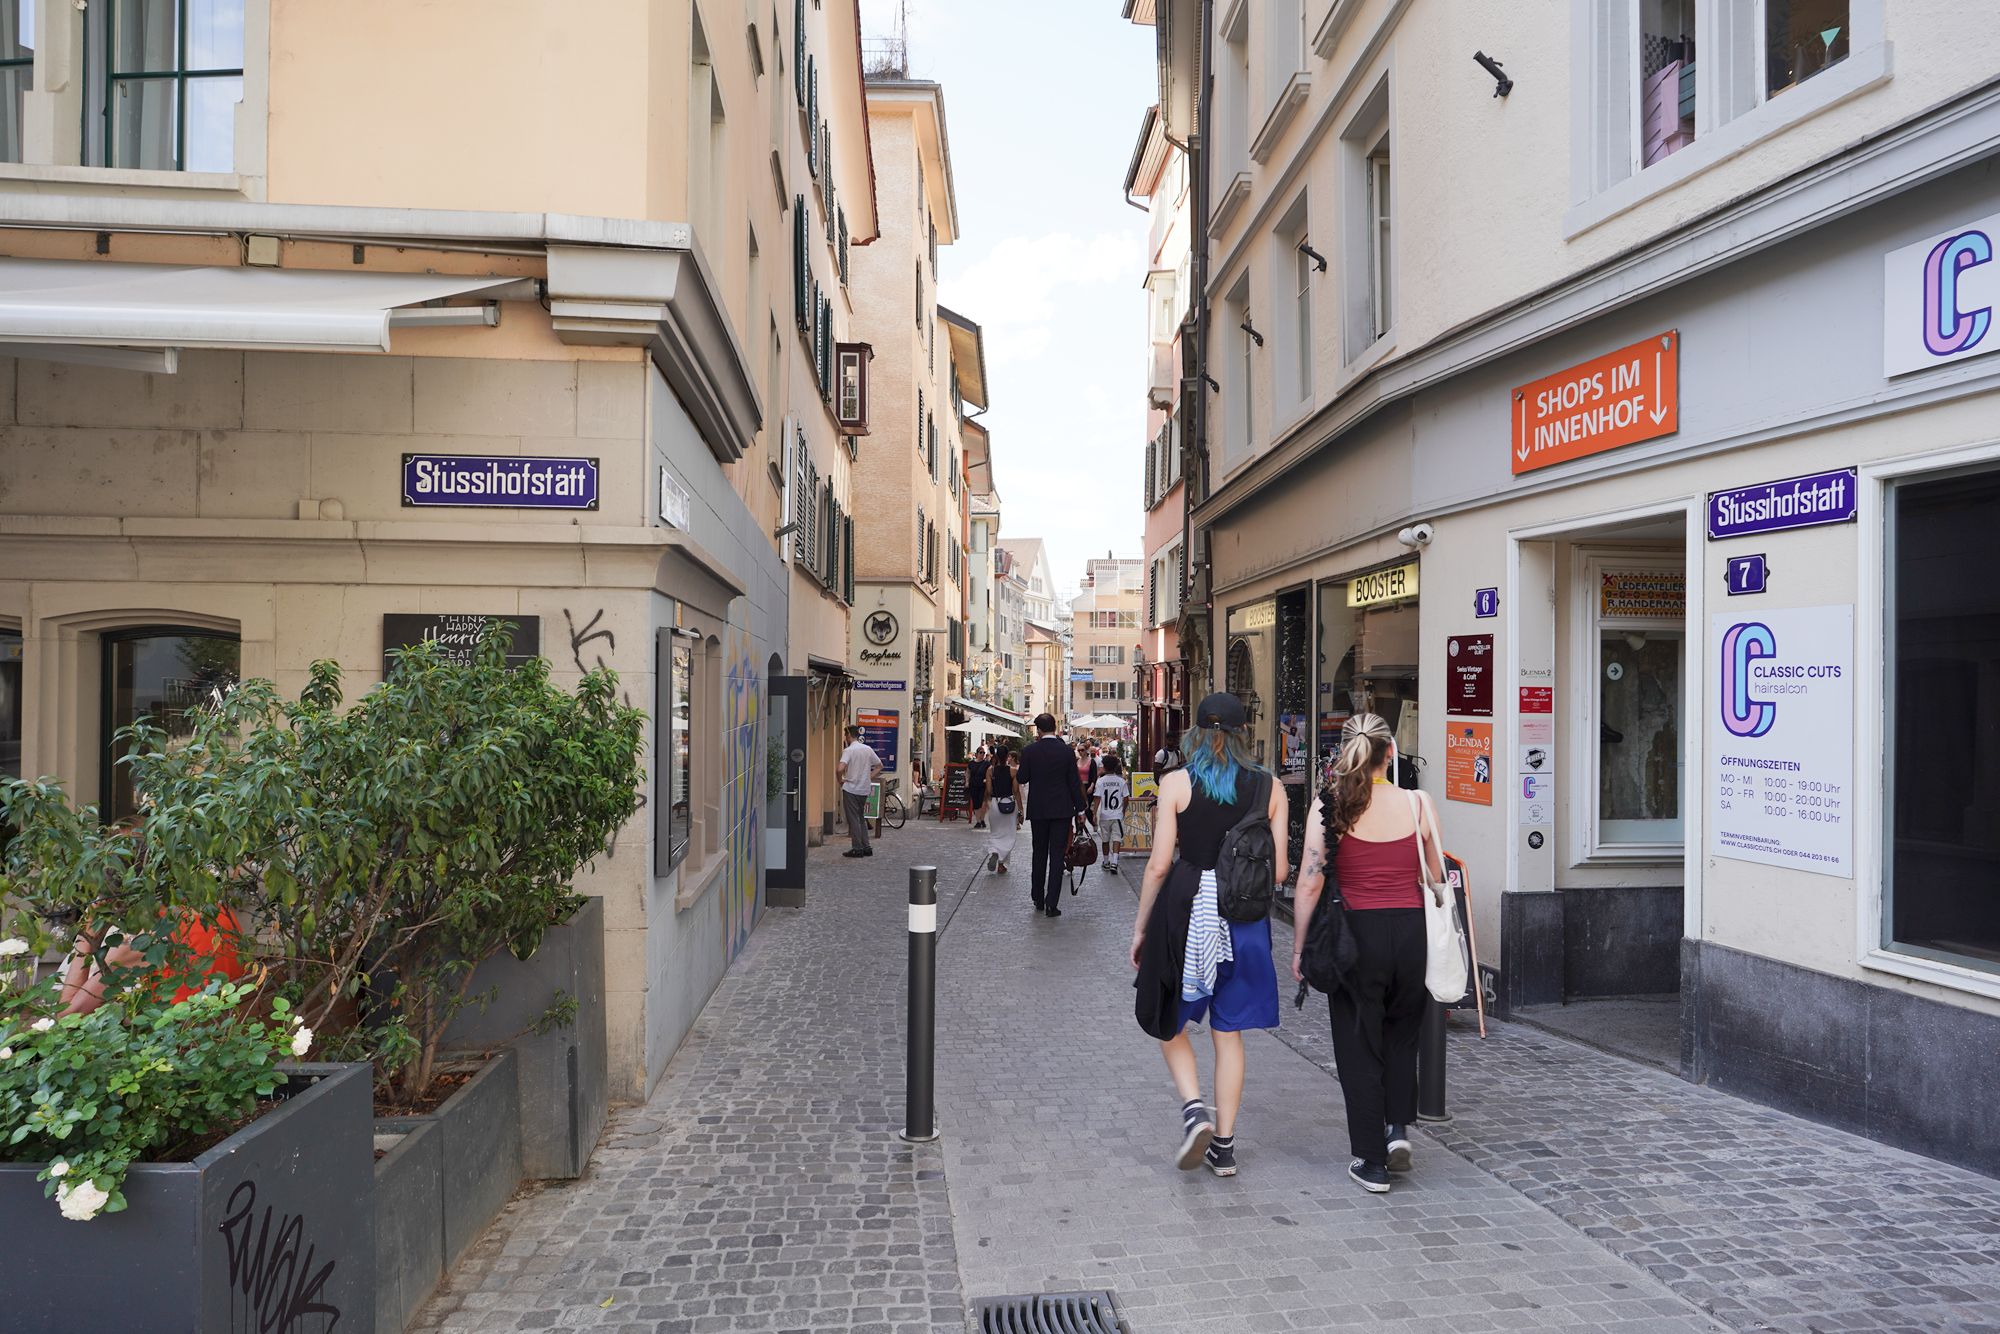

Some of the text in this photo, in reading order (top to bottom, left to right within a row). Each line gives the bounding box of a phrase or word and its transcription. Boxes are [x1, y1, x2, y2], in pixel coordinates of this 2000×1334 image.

[1537, 359, 1640, 418] SHOPS IM
[1534, 394, 1644, 452] INNENHOF
[1717, 479, 1846, 527] Stüssihofstatt
[1356, 568, 1406, 602] BOOSTER
[1738, 562, 1751, 588] 7
[1481, 592, 1490, 613] 6
[438, 615, 487, 624] THINK
[446, 622, 483, 632] HAPPY
[448, 649, 473, 659] EAT
[1753, 665, 1842, 678] CLASSIC CUTS
[1448, 733, 1490, 751] BLENDA 2
[1720, 755, 1801, 772] ÖFFNUNGSZEITEN
[1720, 773, 1735, 784] MO
[1743, 775, 1753, 786] MI
[1764, 777, 1787, 789] 10:00
[1798, 780, 1822, 792] 19:00
[1824, 783, 1841, 794] Uhr
[1104, 789, 1120, 811] 16
[1720, 787, 1734, 797] DO
[1743, 789, 1755, 799] FR
[1764, 792, 1787, 803] 10:00
[1795, 795, 1822, 807] 20:00
[1824, 798, 1841, 809] Uhr
[1720, 800, 1732, 811] SA
[1764, 805, 1787, 817] 10:00
[1798, 809, 1822, 822] 16:00
[1824, 812, 1841, 824] Uhr
[1720, 831, 1782, 846] TERMINVEREINBARUNG:
[1720, 839, 1782, 855] WWW.CLASSICCUTS.CH
[1783, 848, 1798, 857] ODER
[1799, 851, 1811, 859] 044
